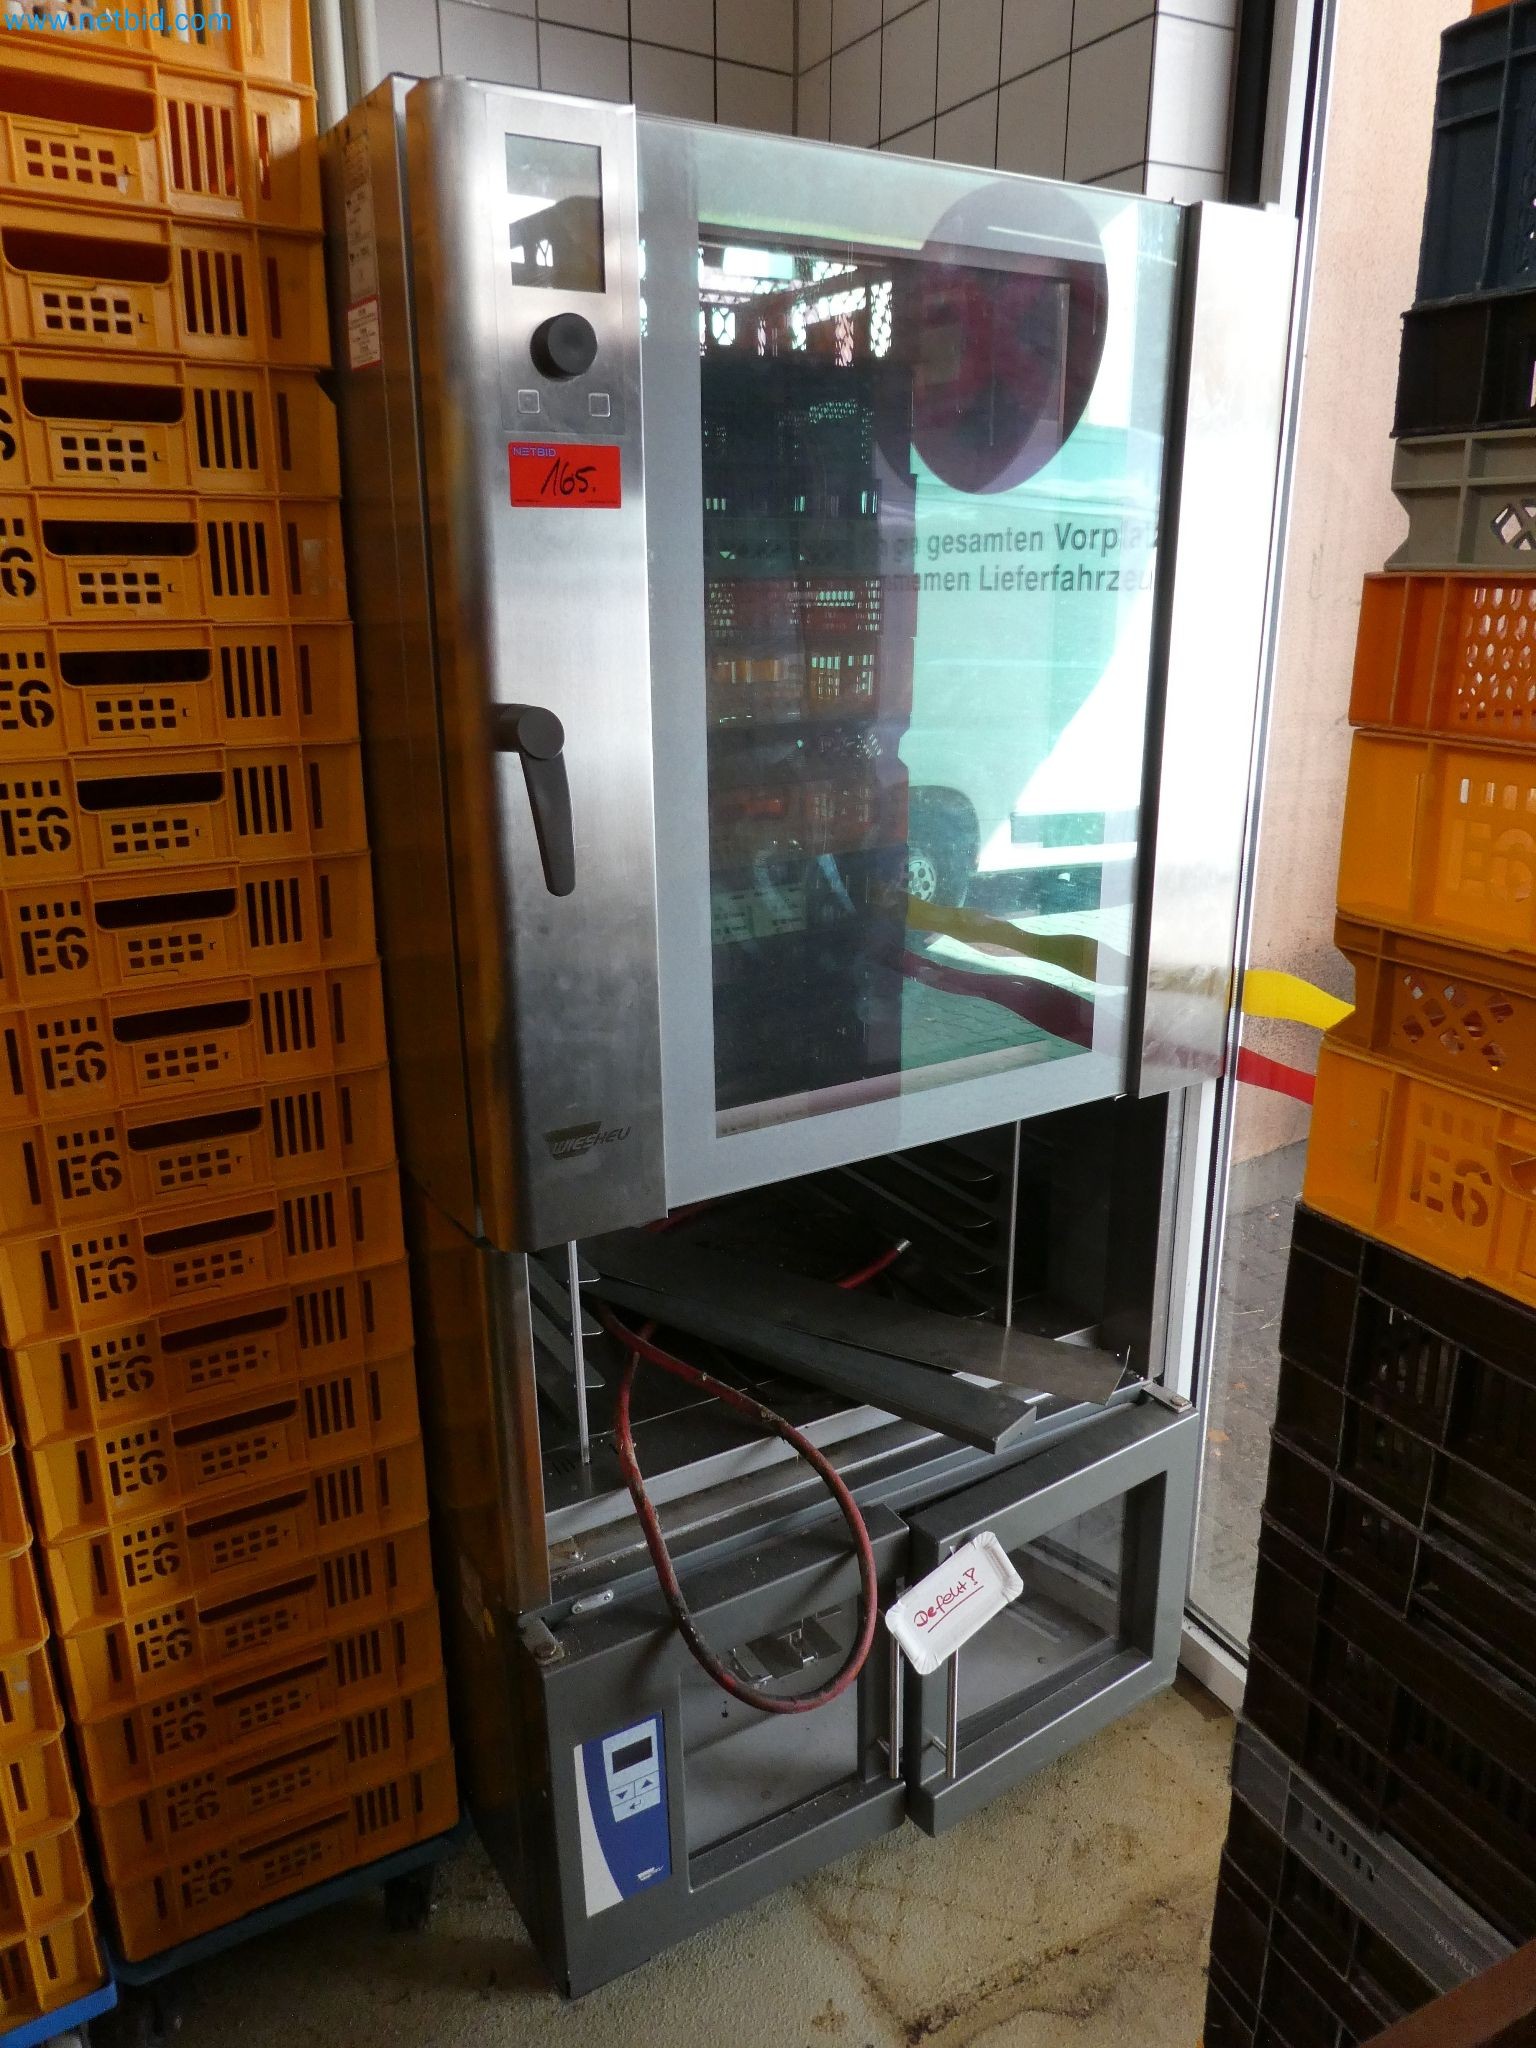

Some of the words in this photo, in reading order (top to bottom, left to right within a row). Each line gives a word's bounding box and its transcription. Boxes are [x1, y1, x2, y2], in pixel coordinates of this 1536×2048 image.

[513, 447, 556, 457] NETBID
[927, 527, 1043, 561] gesamten
[1, 806, 71, 857] E6
[21, 926, 89, 976] E6
[41, 1041, 107, 1090] E6
[57, 1150, 122, 1199] E6
[75, 1255, 138, 1303] E6
[94, 1355, 154, 1401] E6
[109, 1450, 168, 1496] E6
[123, 1541, 181, 1587] E6
[136, 1627, 193, 1673] E6
[153, 1710, 208, 1754] E6
